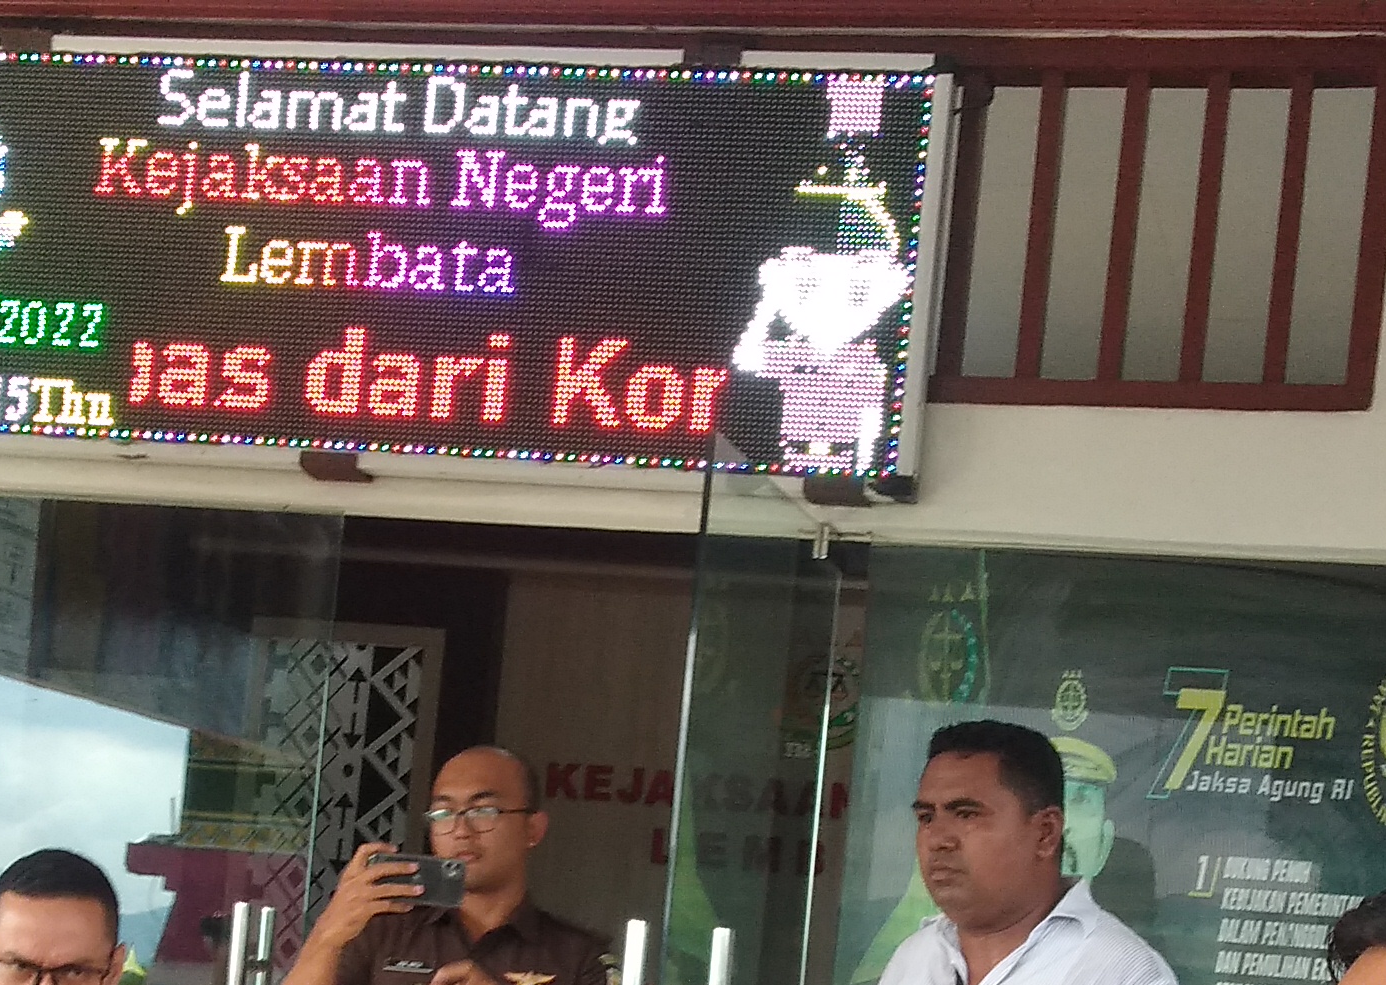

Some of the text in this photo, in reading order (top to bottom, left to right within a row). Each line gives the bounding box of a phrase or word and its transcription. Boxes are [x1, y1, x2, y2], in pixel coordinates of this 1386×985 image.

[158, 69, 641, 145] Selamat Datang
[93, 137, 666, 229] Kejaksaan Negeri
[220, 225, 515, 293] Lembata
[305, 327, 511, 422] dari
[1205, 735, 1295, 770] Harian
[1222, 703, 1336, 740] Perintah
[1186, 770, 1355, 804] Jaksa Agung RI
